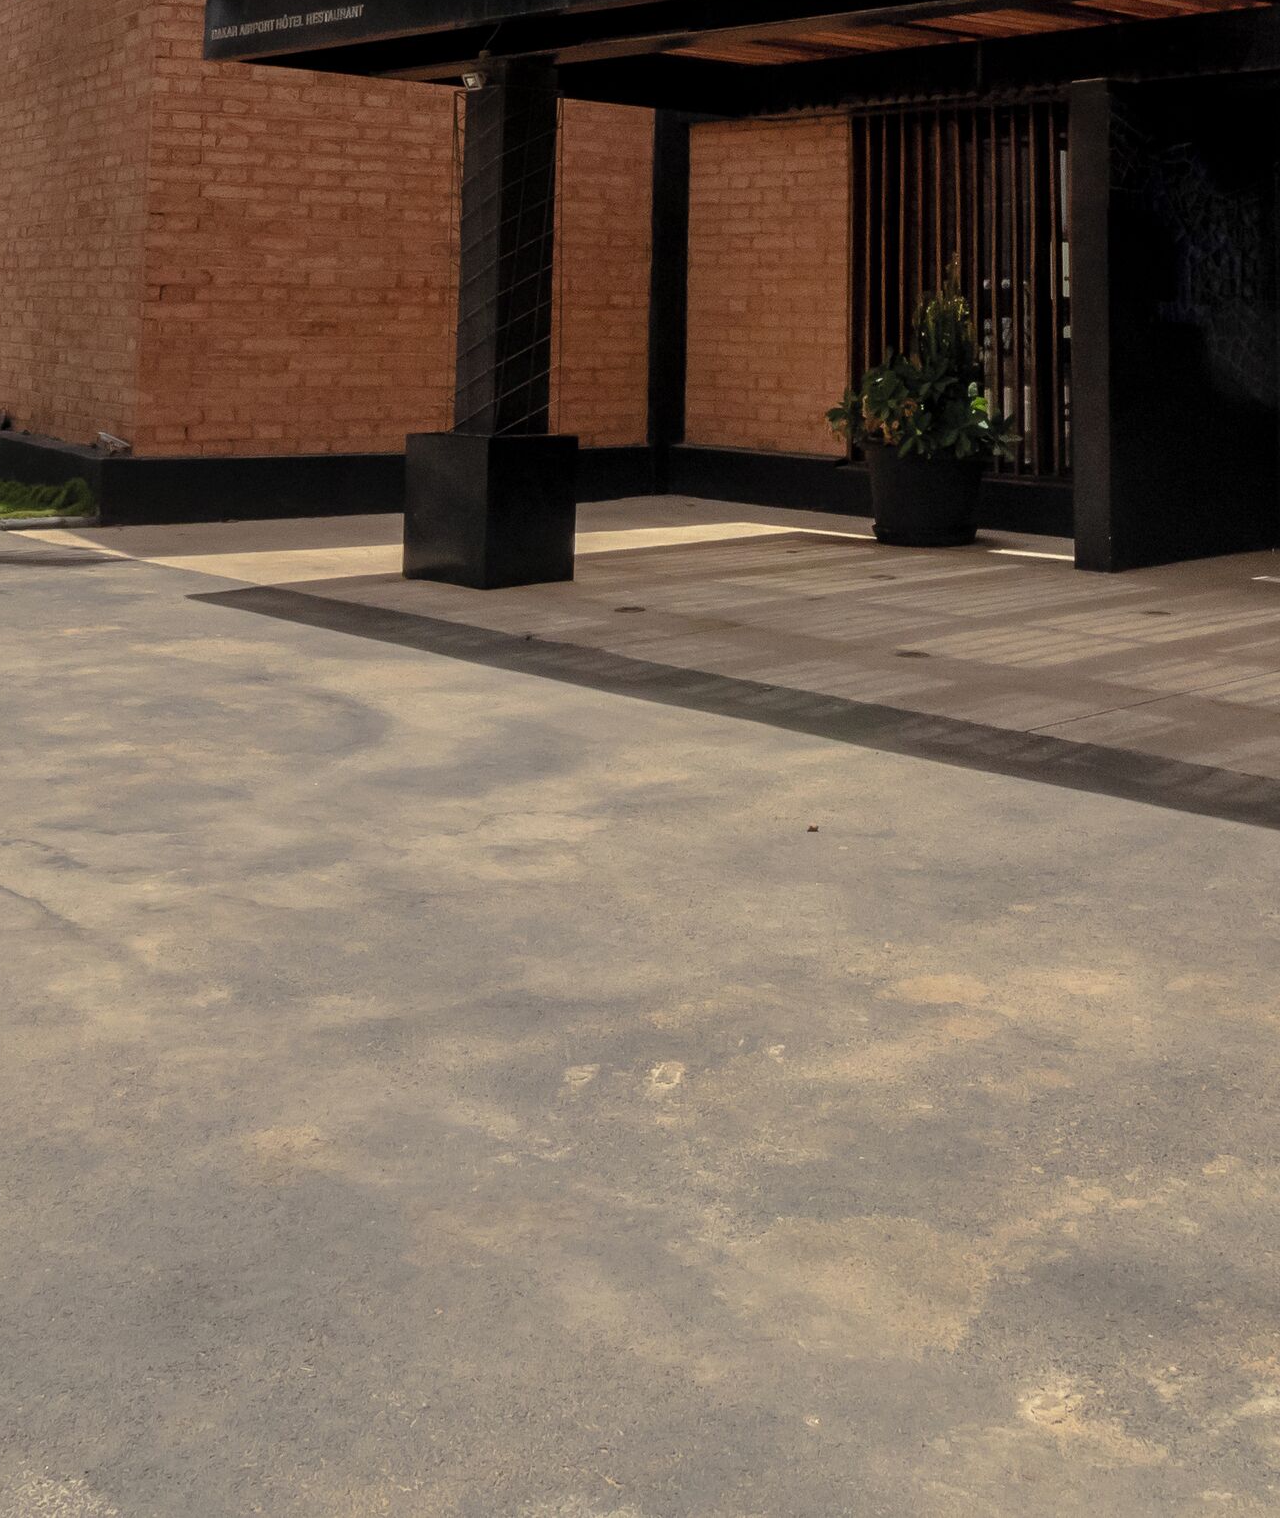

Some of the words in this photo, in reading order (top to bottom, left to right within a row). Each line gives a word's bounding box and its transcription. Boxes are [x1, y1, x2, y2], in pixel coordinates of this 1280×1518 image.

[211, 25, 238, 40] DAKAR
[239, 19, 275, 36] AIRPORT
[276, 14, 304, 29] HÔTEL
[305, 4, 364, 25] RESTAURANT
